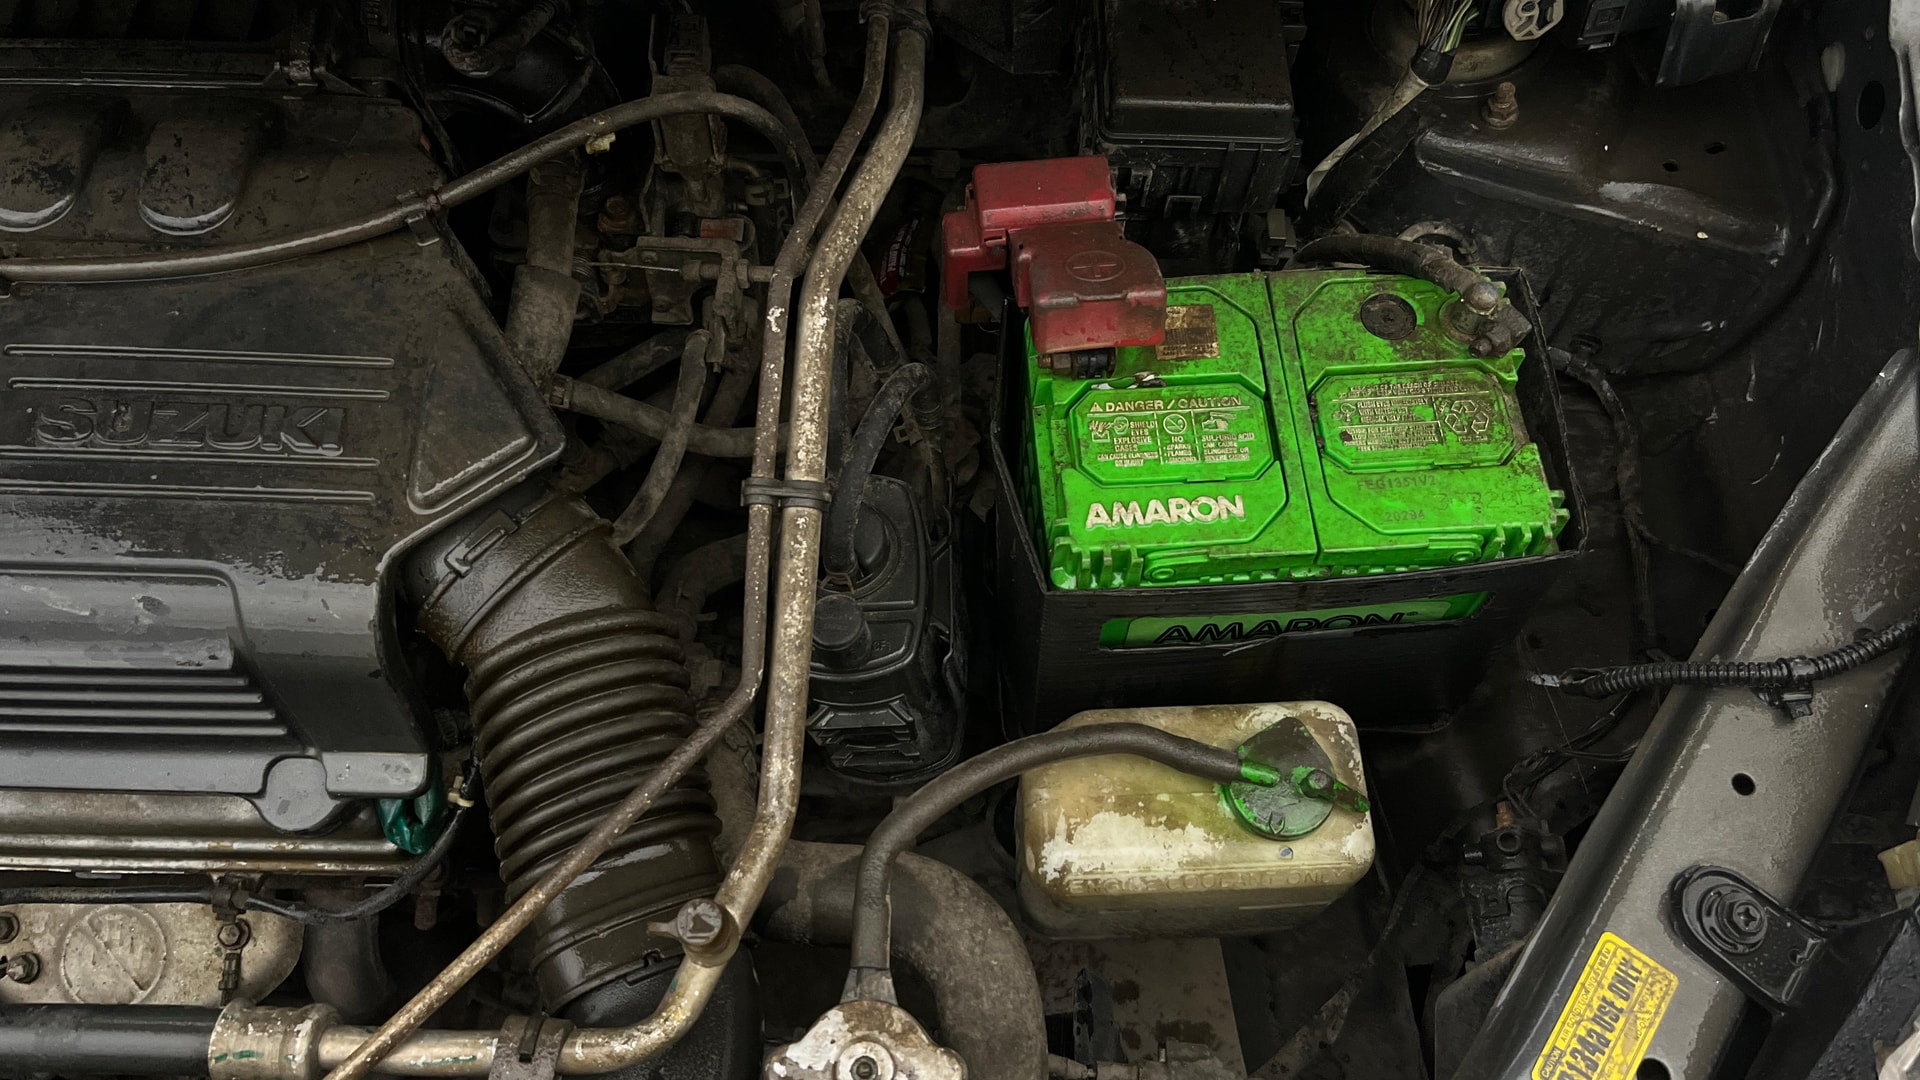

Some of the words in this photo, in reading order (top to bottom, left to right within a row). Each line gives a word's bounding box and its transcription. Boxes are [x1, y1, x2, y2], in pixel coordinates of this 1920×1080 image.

[1105, 400, 1164, 412] DANGER
[1178, 396, 1242, 409] CAUTION
[37, 397, 346, 457] SUZUKI
[1130, 421, 1156, 429] SHIELD
[1131, 428, 1149, 436] EYES
[1113, 436, 1152, 445] EXPLOSIVE
[1238, 432, 1255, 441] ACID
[1114, 444, 1138, 452] GASES
[1167, 443, 1191, 451] SPARKS
[1086, 494, 1246, 530] AMARON
[1165, 869, 1275, 890] COOLANT
[1286, 866, 1348, 886] ONLY
[1607, 956, 1643, 1002] ONLY
[1541, 1048, 1562, 1078] CAUTION
[1559, 1029, 1571, 1043] AIR
[1568, 976, 1598, 1029] CONDITIONING
[1594, 947, 1613, 976] SYSTEM
[1591, 995, 1625, 1034] USE
